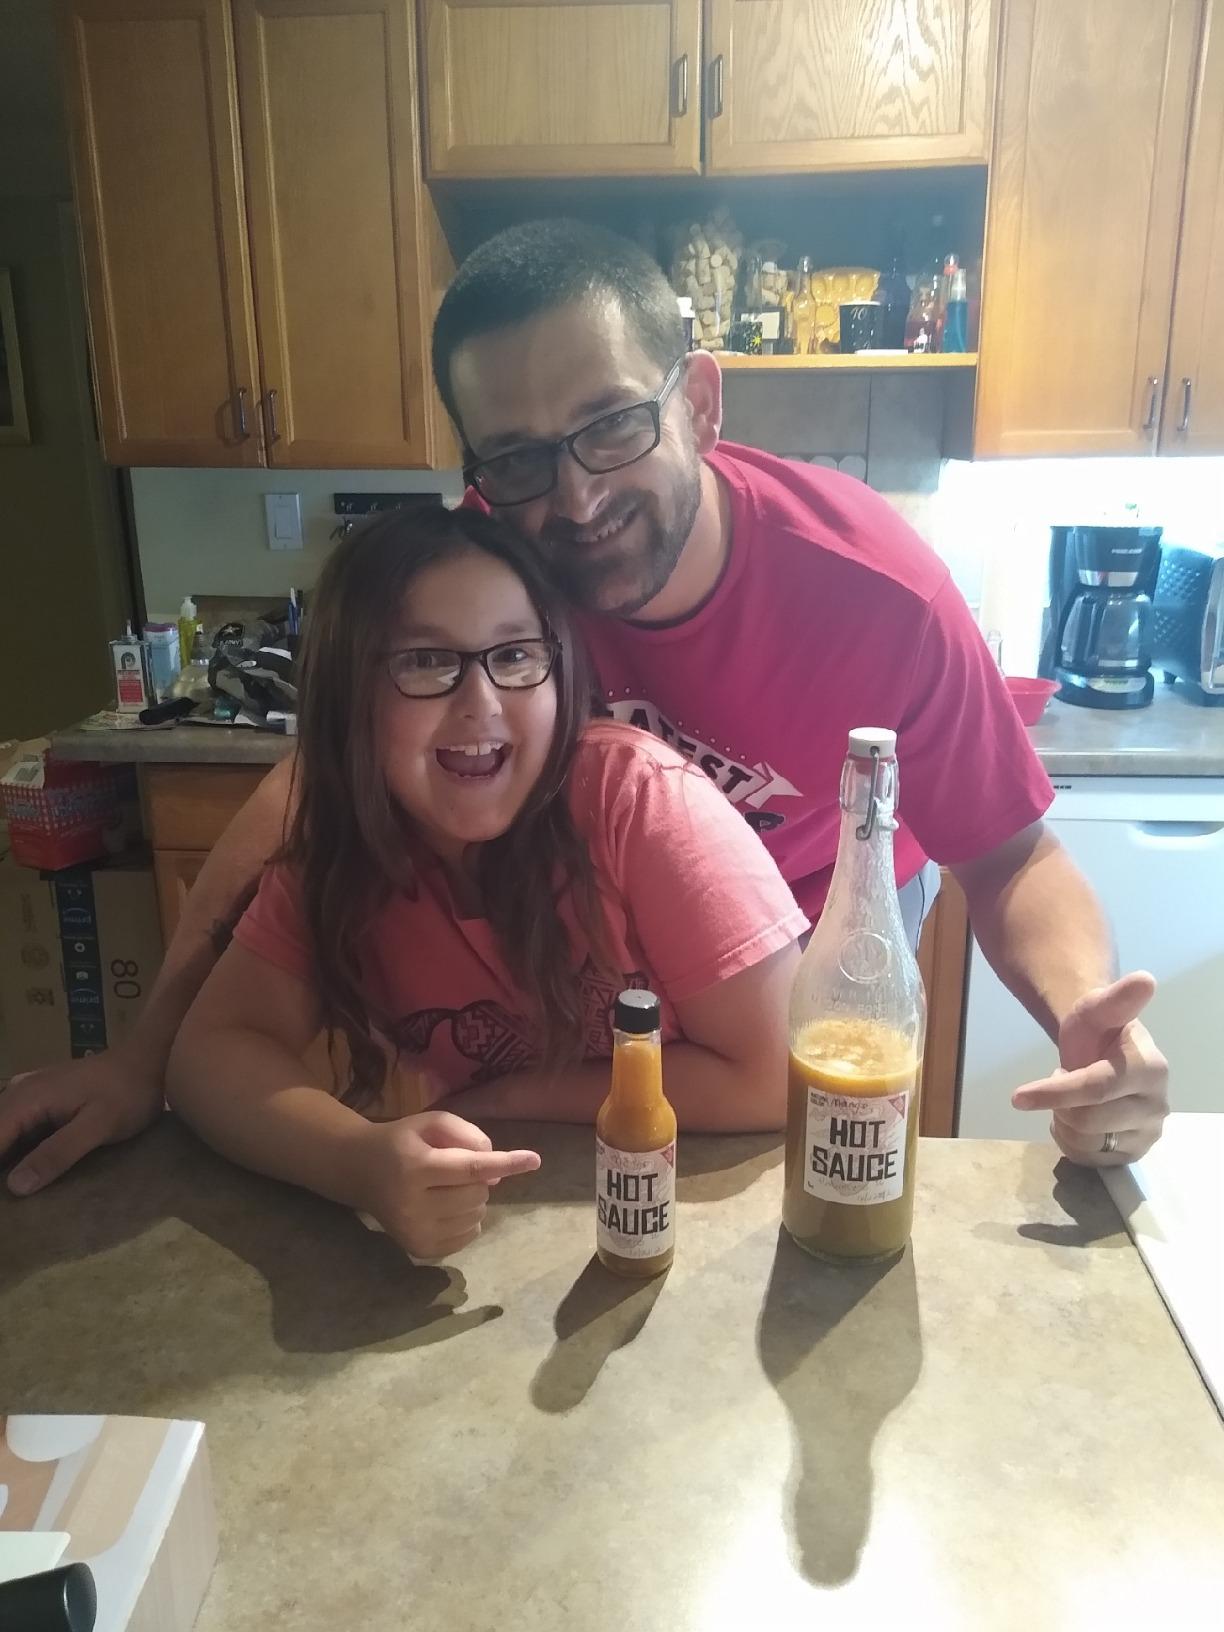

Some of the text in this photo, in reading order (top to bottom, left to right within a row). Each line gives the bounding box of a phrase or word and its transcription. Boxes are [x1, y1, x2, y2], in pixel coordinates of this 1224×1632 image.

[111, 958, 141, 999] 80
[829, 1117, 886, 1148] HOT
[812, 1144, 898, 1182] SAUCE
[607, 1169, 658, 1202] HOT
[598, 1193, 670, 1236] SAUCE
